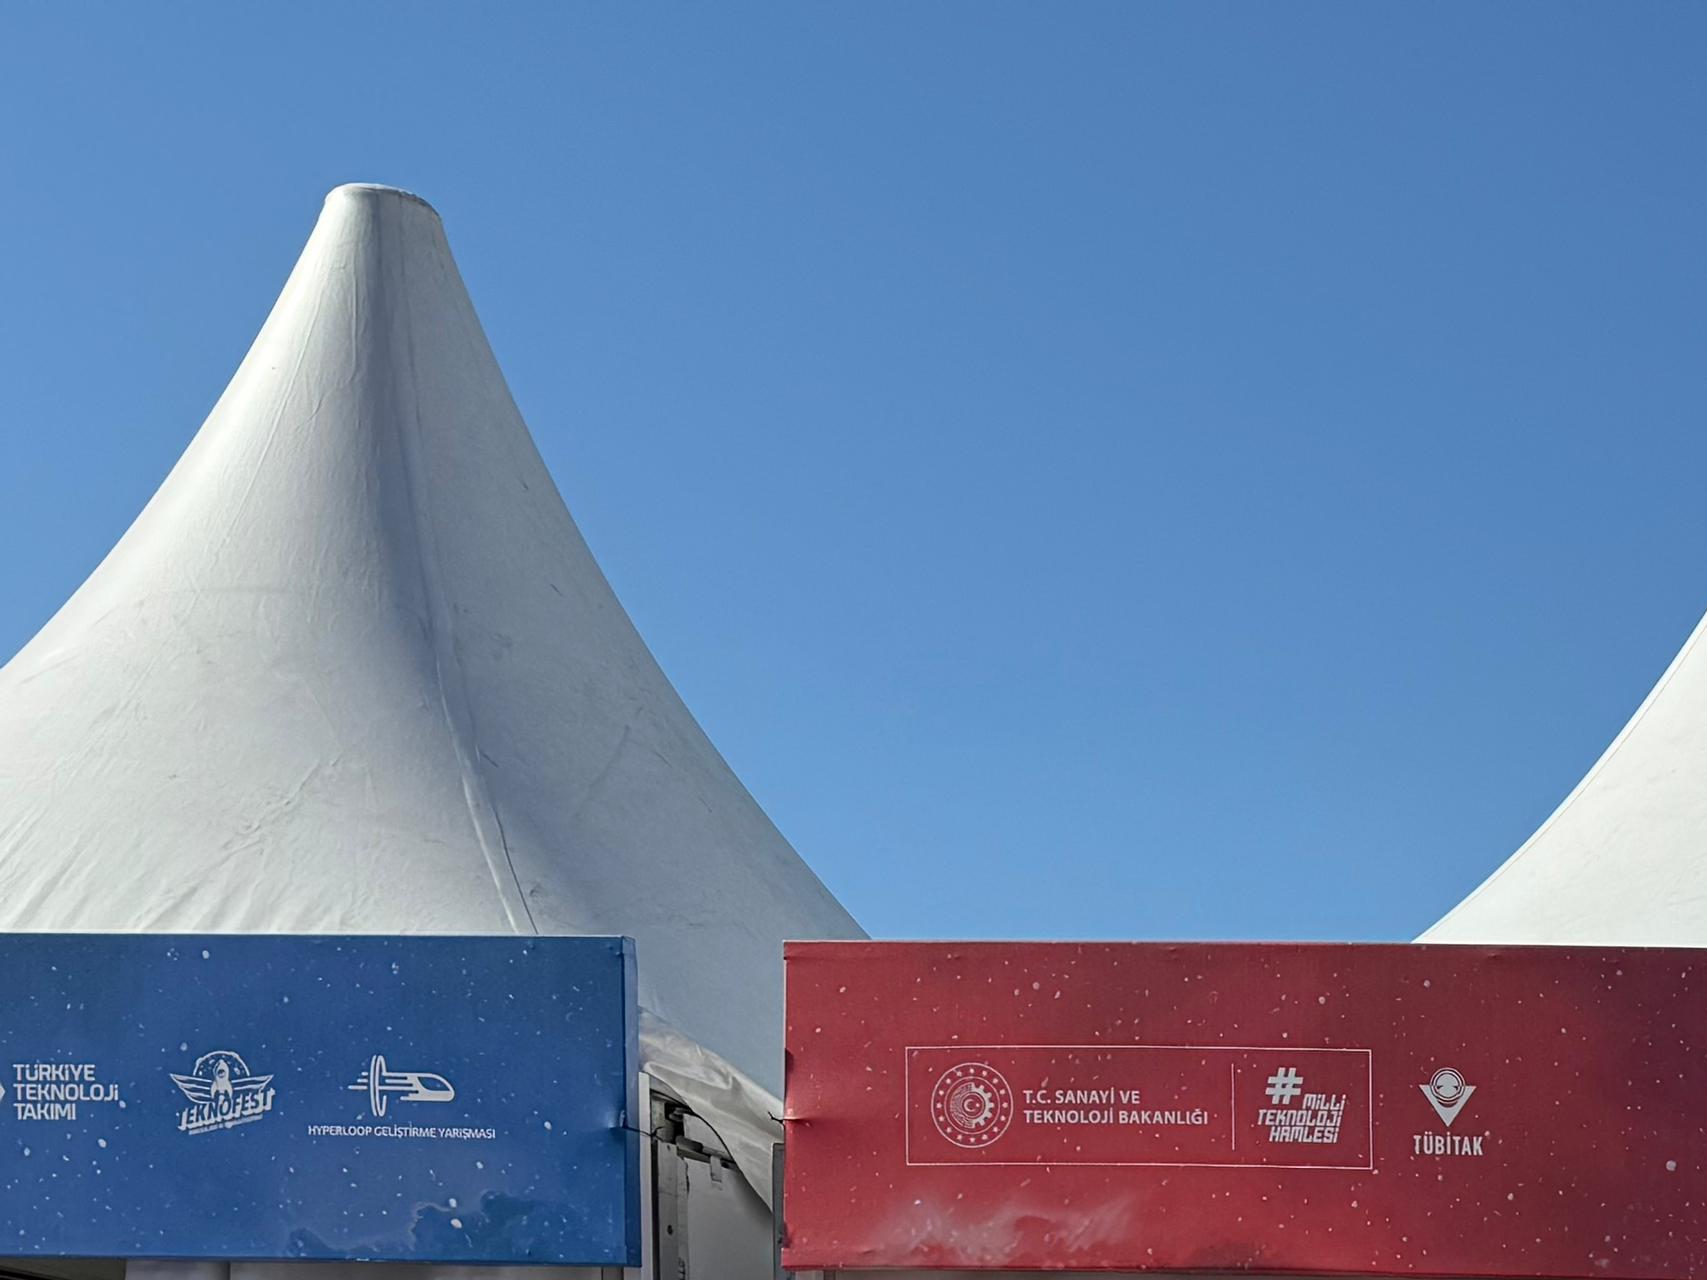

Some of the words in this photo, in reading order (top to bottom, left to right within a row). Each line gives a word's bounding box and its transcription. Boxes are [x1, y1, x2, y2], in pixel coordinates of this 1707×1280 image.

[1024, 1089, 1052, 1104] T.C.
[1055, 1087, 1115, 1104] SANAYİ
[1119, 1090, 1140, 1105] VE
[14, 1103, 76, 1120] TAKIMI
[177, 1088, 276, 1131] TEKNOFEST
[1024, 1107, 1114, 1125] TEKNOLOJİ
[1118, 1109, 1208, 1126] BAKANLIĞI
[308, 1125, 372, 1136] HYPERLOOP
[1413, 1130, 1484, 1156] TÜBİTAK
